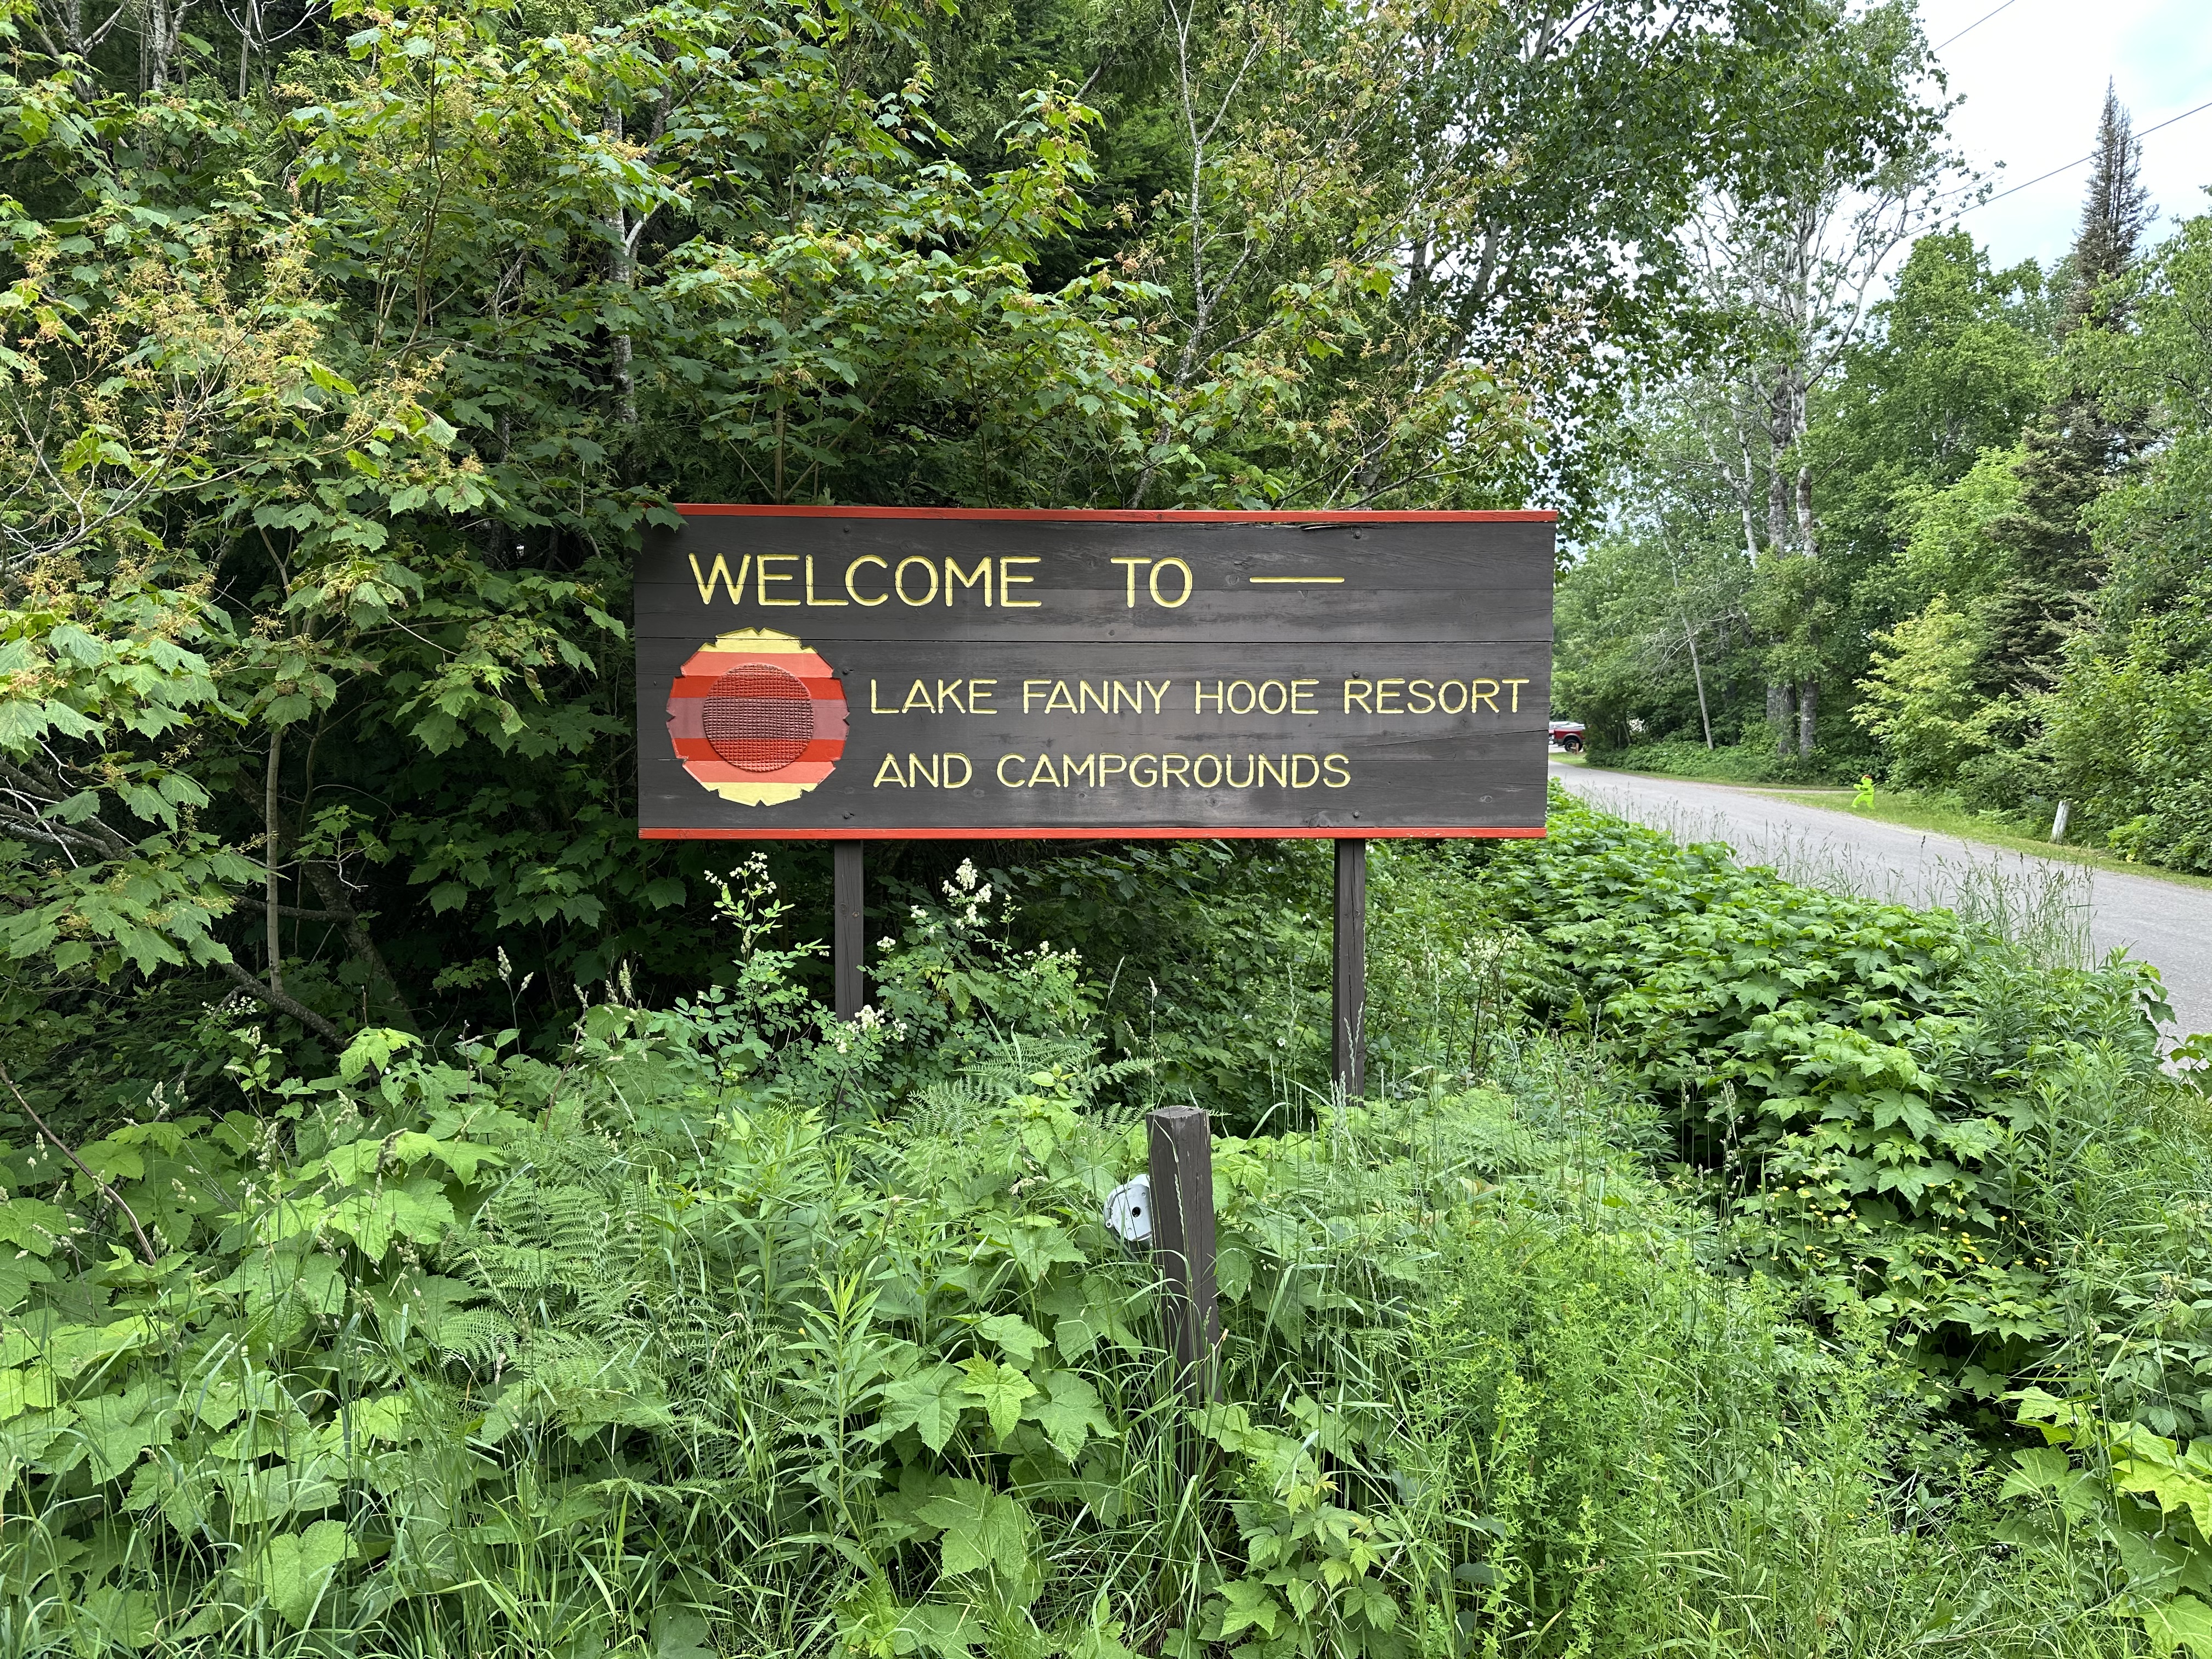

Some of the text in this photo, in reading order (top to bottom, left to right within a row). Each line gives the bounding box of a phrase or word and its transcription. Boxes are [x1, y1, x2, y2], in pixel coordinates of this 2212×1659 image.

[688, 552, 1042, 607] WELCOME
[1110, 557, 1193, 608] TO
[870, 678, 1530, 714] LAKE FANNY HOOE RESORT
[873, 752, 1351, 788] AND CAMPGROUNDS
